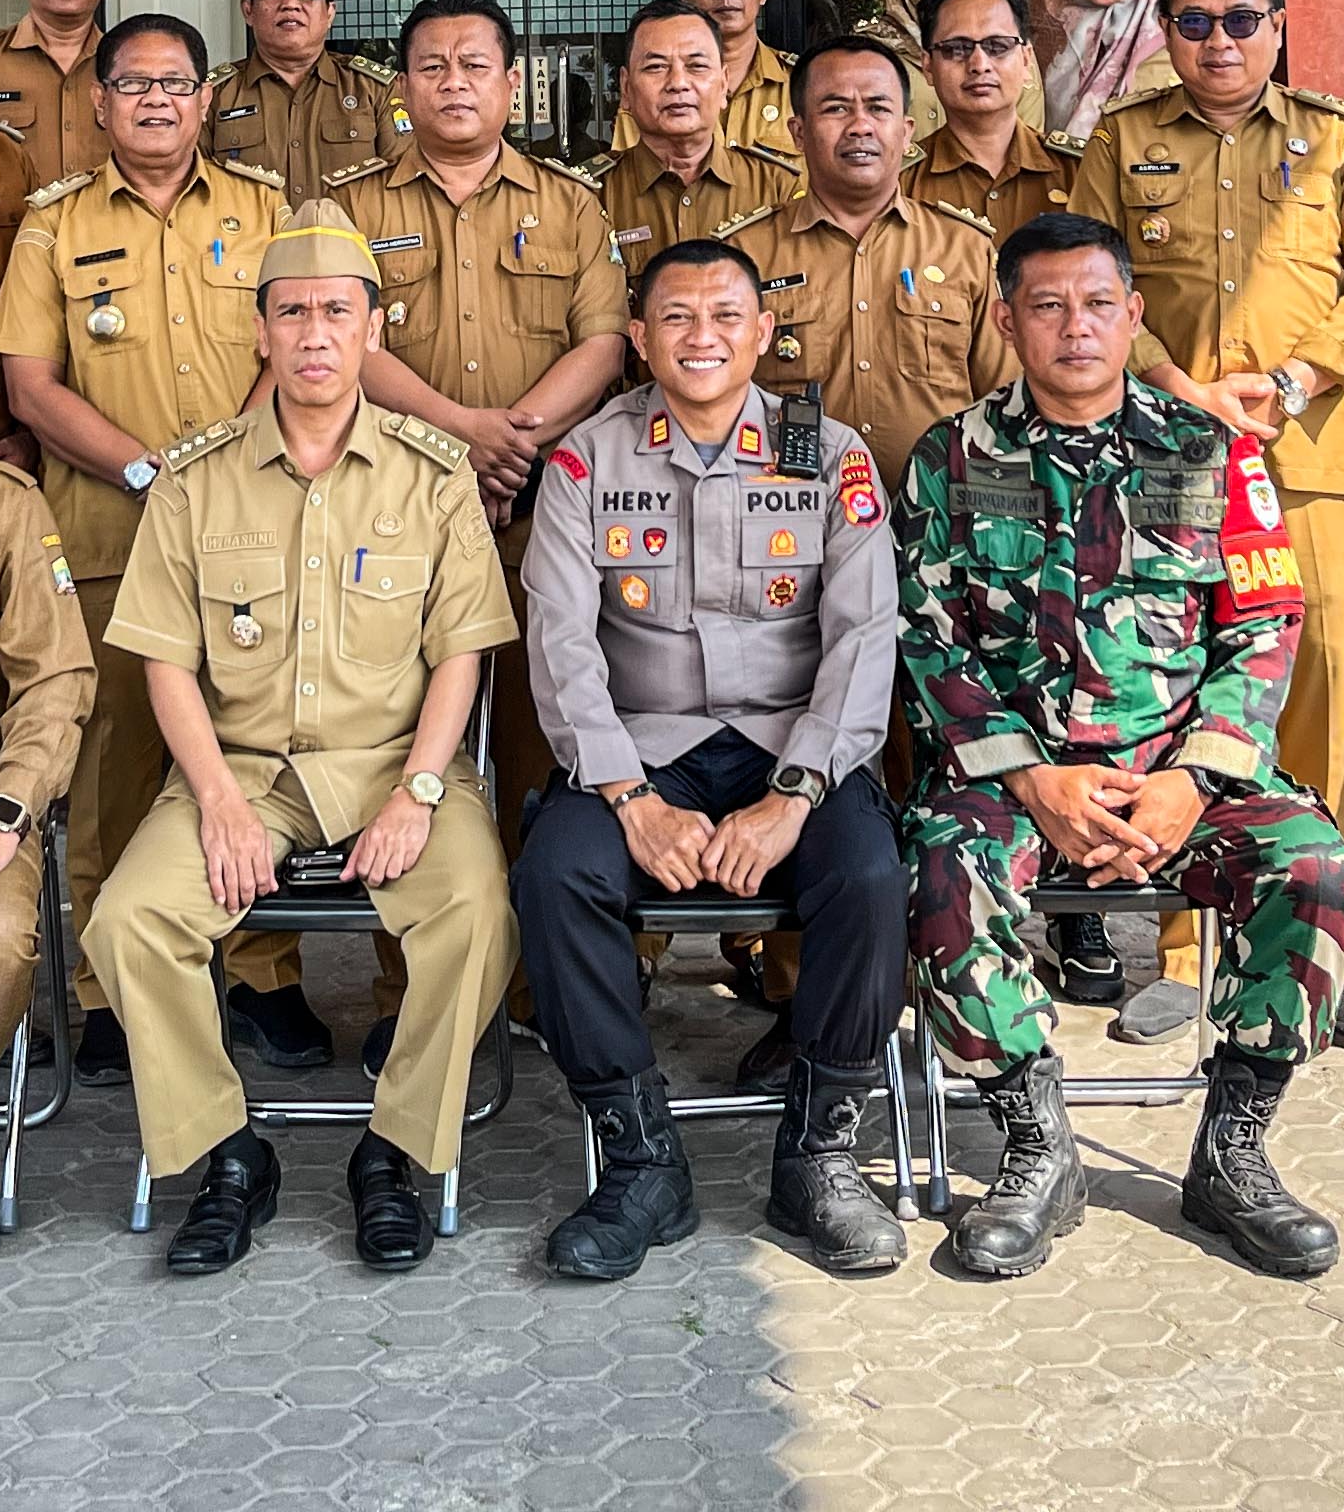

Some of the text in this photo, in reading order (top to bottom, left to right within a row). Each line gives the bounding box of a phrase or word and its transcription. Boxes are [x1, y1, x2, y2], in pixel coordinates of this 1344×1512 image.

[602, 491, 672, 513] HERY
[747, 490, 820, 513] POLRI
[1142, 502, 1179, 519] TNI
